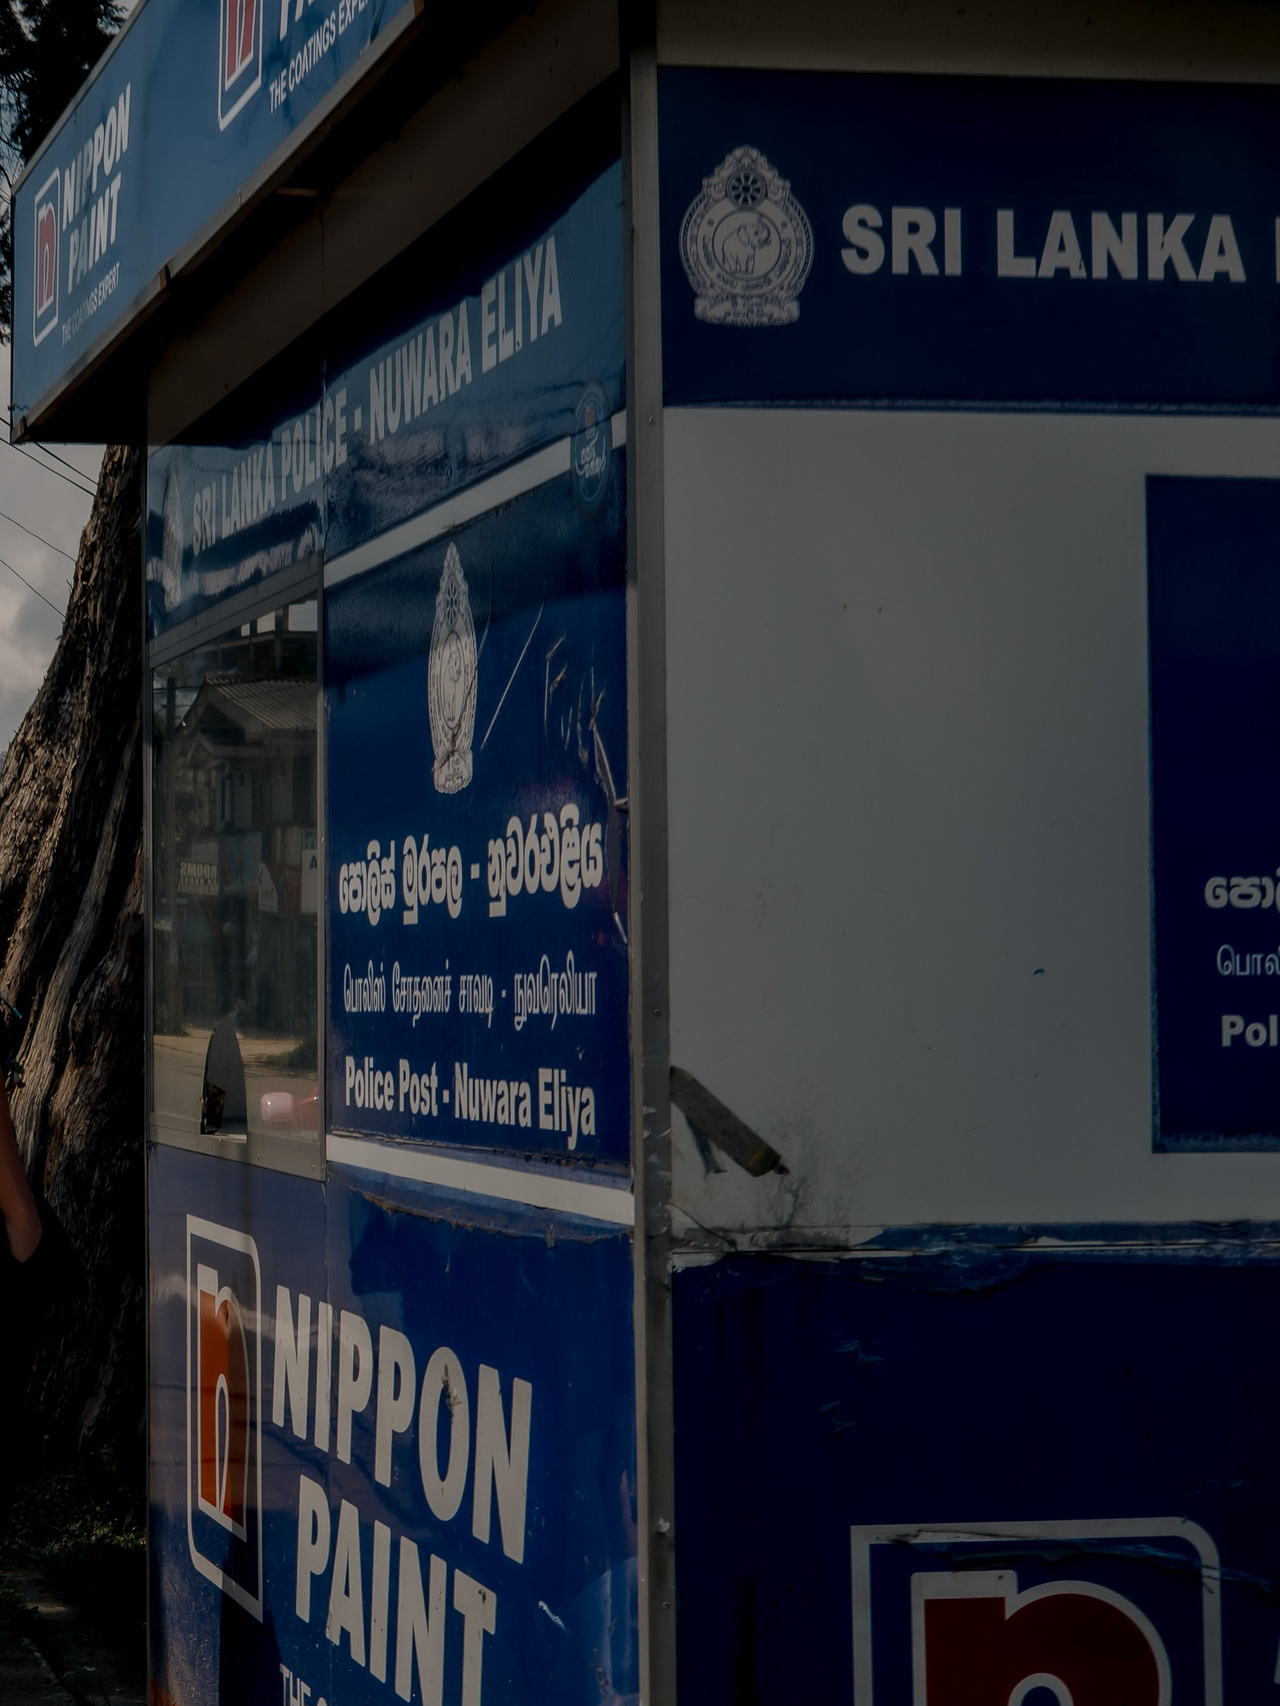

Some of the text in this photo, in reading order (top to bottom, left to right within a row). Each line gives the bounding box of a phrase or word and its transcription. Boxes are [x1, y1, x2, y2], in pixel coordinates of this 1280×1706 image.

[270, 68, 287, 114] THE
[288, 10, 336, 93] COATINGS
[63, 81, 131, 233] NIPPON
[67, 171, 121, 295] PAINT
[840, 203, 962, 277] SRI
[996, 208, 1247, 283] LANKA
[192, 481, 216, 557] SRI
[221, 441, 275, 540] LANKA
[281, 387, 348, 503] POLICE
[369, 300, 472, 446] NUWARA
[481, 235, 562, 375] ELIYA
[345, 1055, 394, 1112] Police
[398, 1058, 438, 1117] Post
[454, 1061, 532, 1128] Nuwara
[538, 1067, 596, 1151] Eliya
[272, 1284, 533, 1565] NIPPON
[295, 1474, 497, 1706] PAINT
